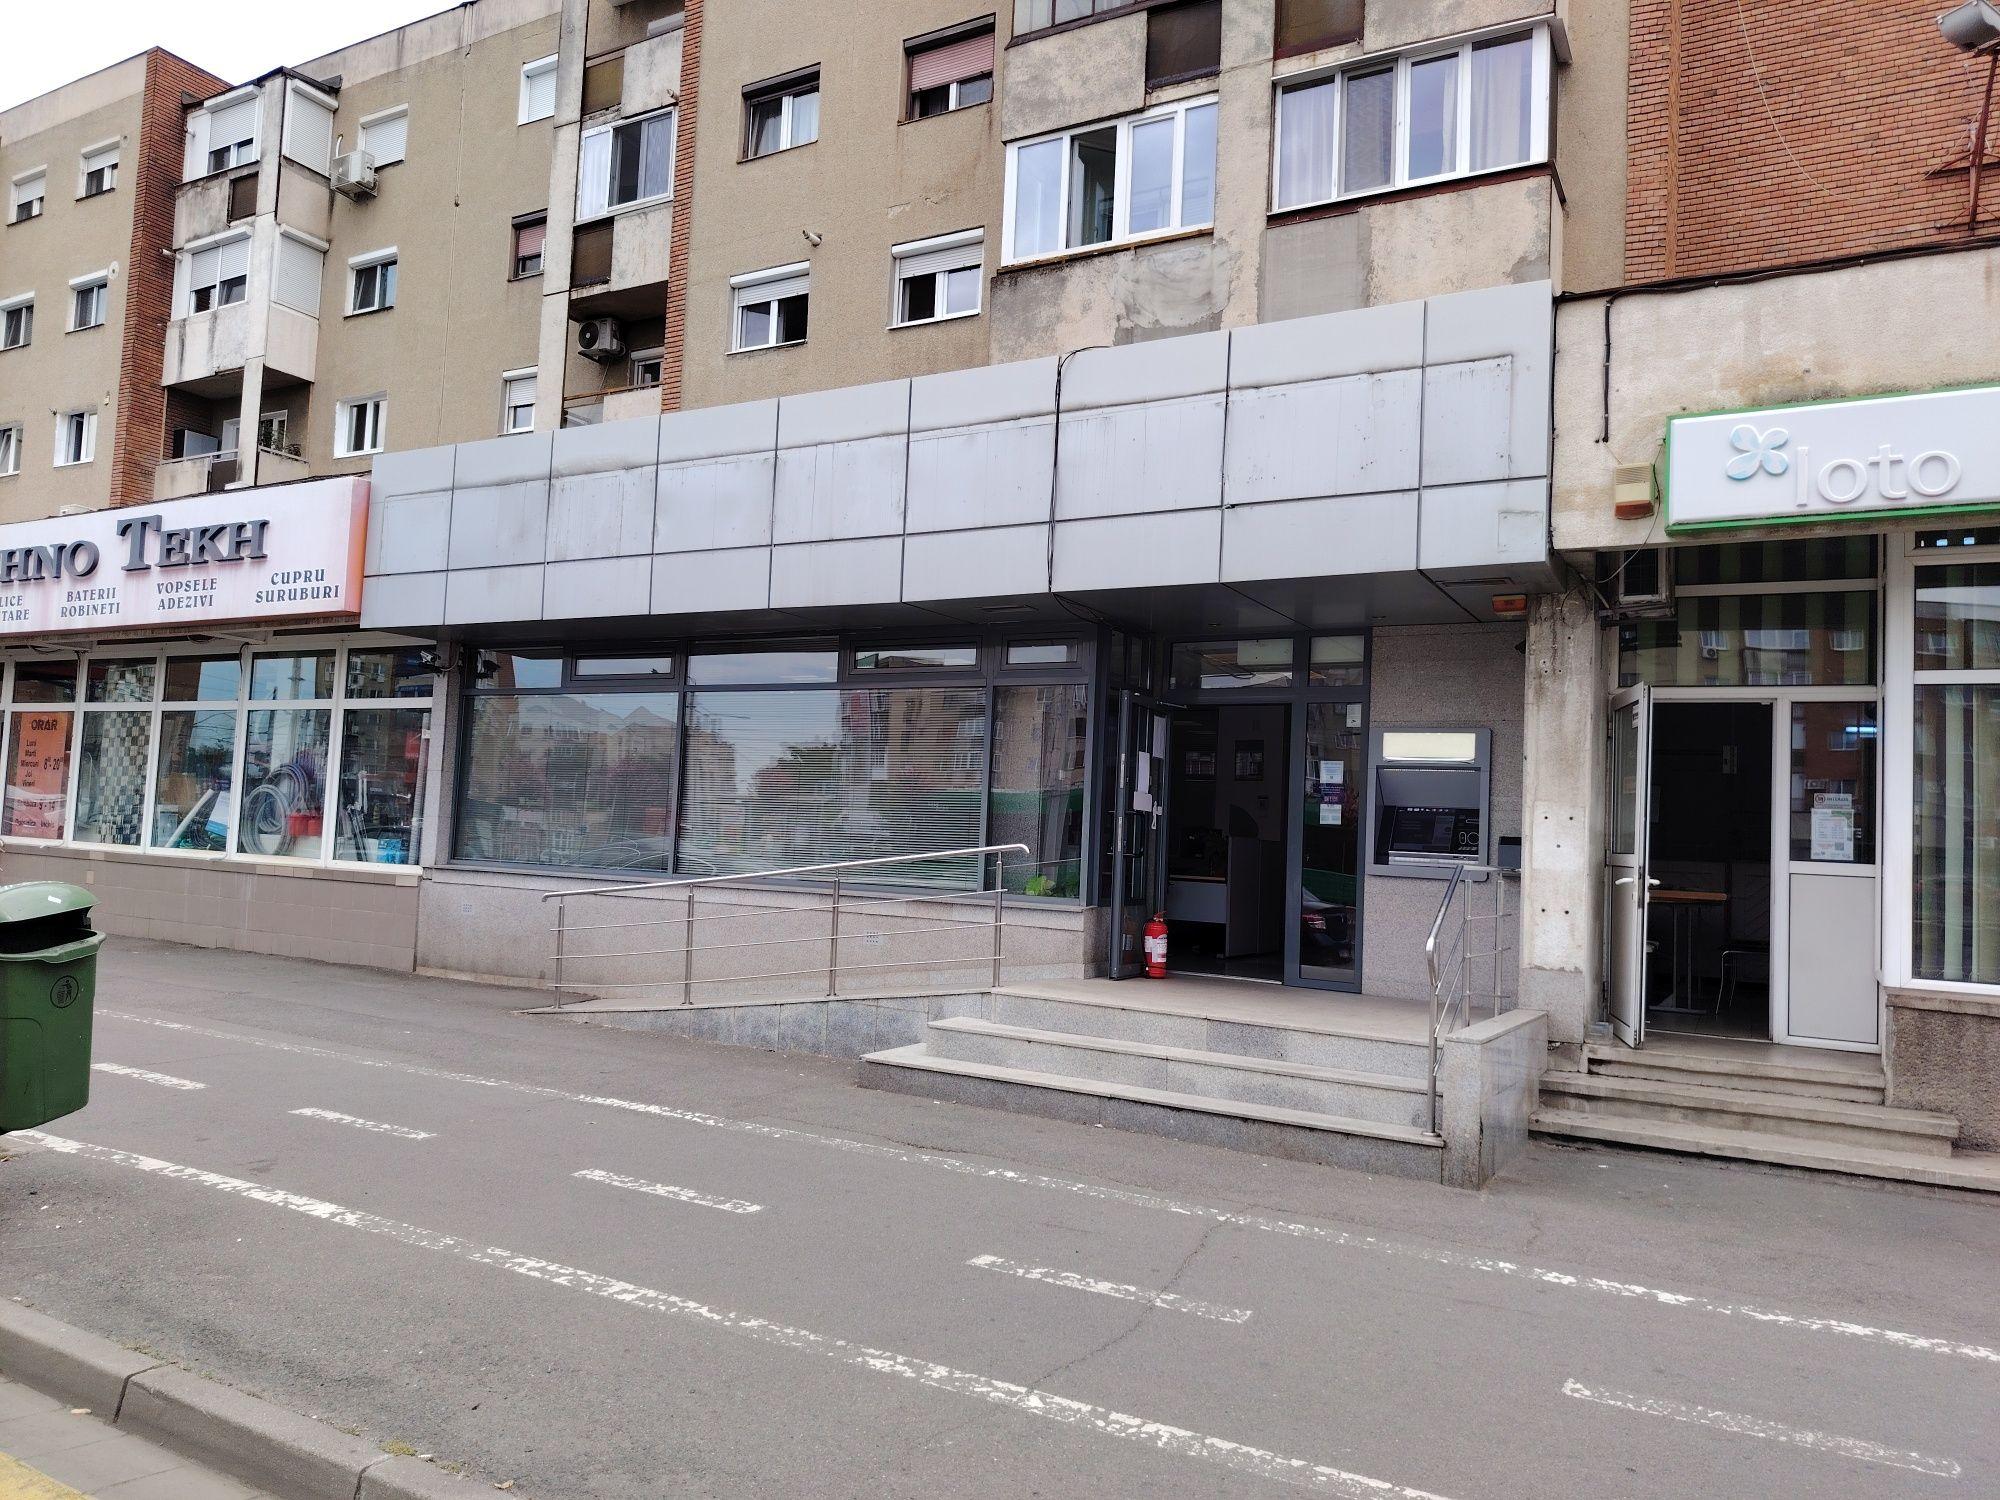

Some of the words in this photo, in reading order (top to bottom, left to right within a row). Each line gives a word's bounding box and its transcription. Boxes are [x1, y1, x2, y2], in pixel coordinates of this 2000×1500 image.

[1796, 444, 1961, 507] loto
[116, 514, 270, 572] TEKH
[156, 577, 217, 595] VOPSELE
[271, 568, 326, 587] CUPRU
[66, 587, 117, 603] BATERII
[157, 594, 214, 611] ADEZIVI
[255, 585, 340, 604] SURUBURI
[0, 609, 30, 622] TARE
[60, 602, 121, 618] ROBINETI
[31, 719, 58, 731] ORAR
